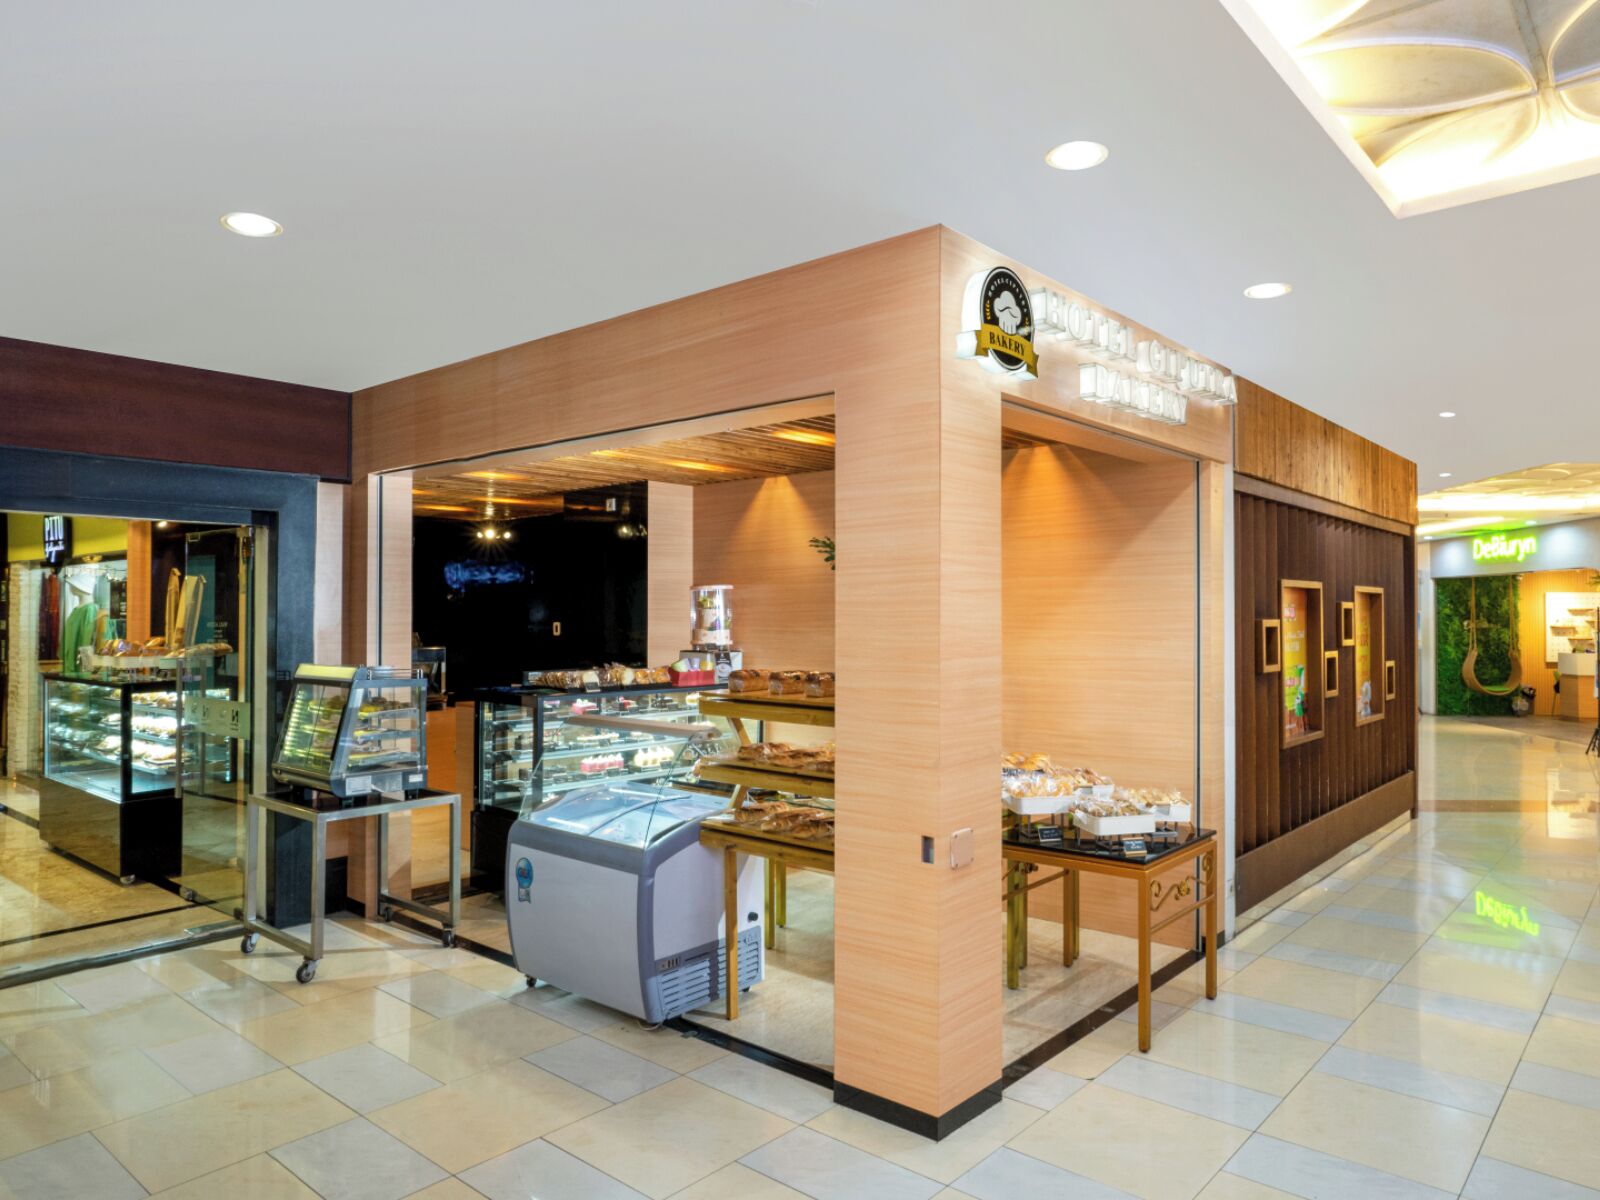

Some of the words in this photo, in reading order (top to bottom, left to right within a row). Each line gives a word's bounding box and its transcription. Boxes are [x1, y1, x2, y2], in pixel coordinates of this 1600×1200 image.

[989, 331, 1025, 356] BAKERY
[1036, 287, 1136, 362] HOTEL
[1078, 362, 1188, 425] BAKERY
